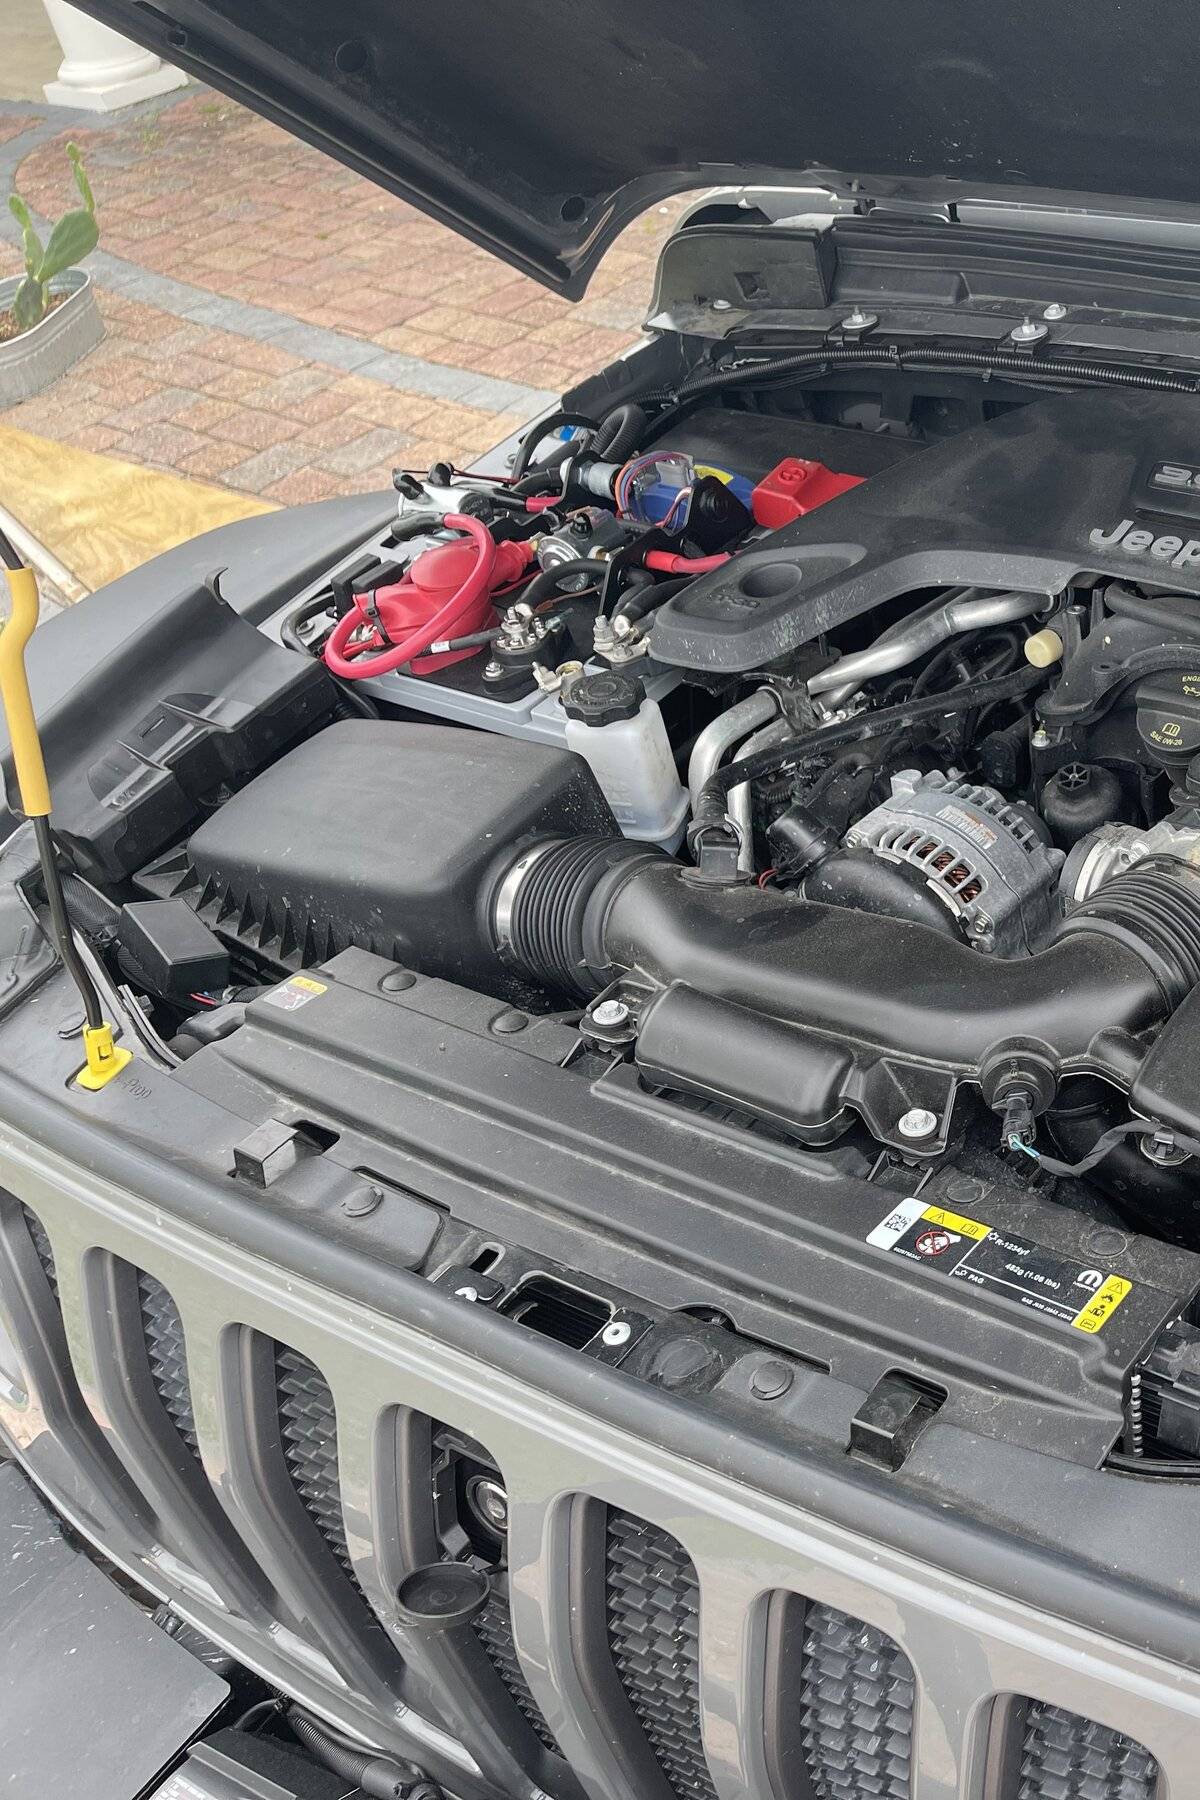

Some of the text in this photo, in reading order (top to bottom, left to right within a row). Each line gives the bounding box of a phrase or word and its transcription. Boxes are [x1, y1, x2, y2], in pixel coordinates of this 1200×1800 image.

[1150, 730, 1162, 743] SAE
[995, 1237, 1031, 1257] R-1234yf
[967, 1273, 985, 1285] PAG
